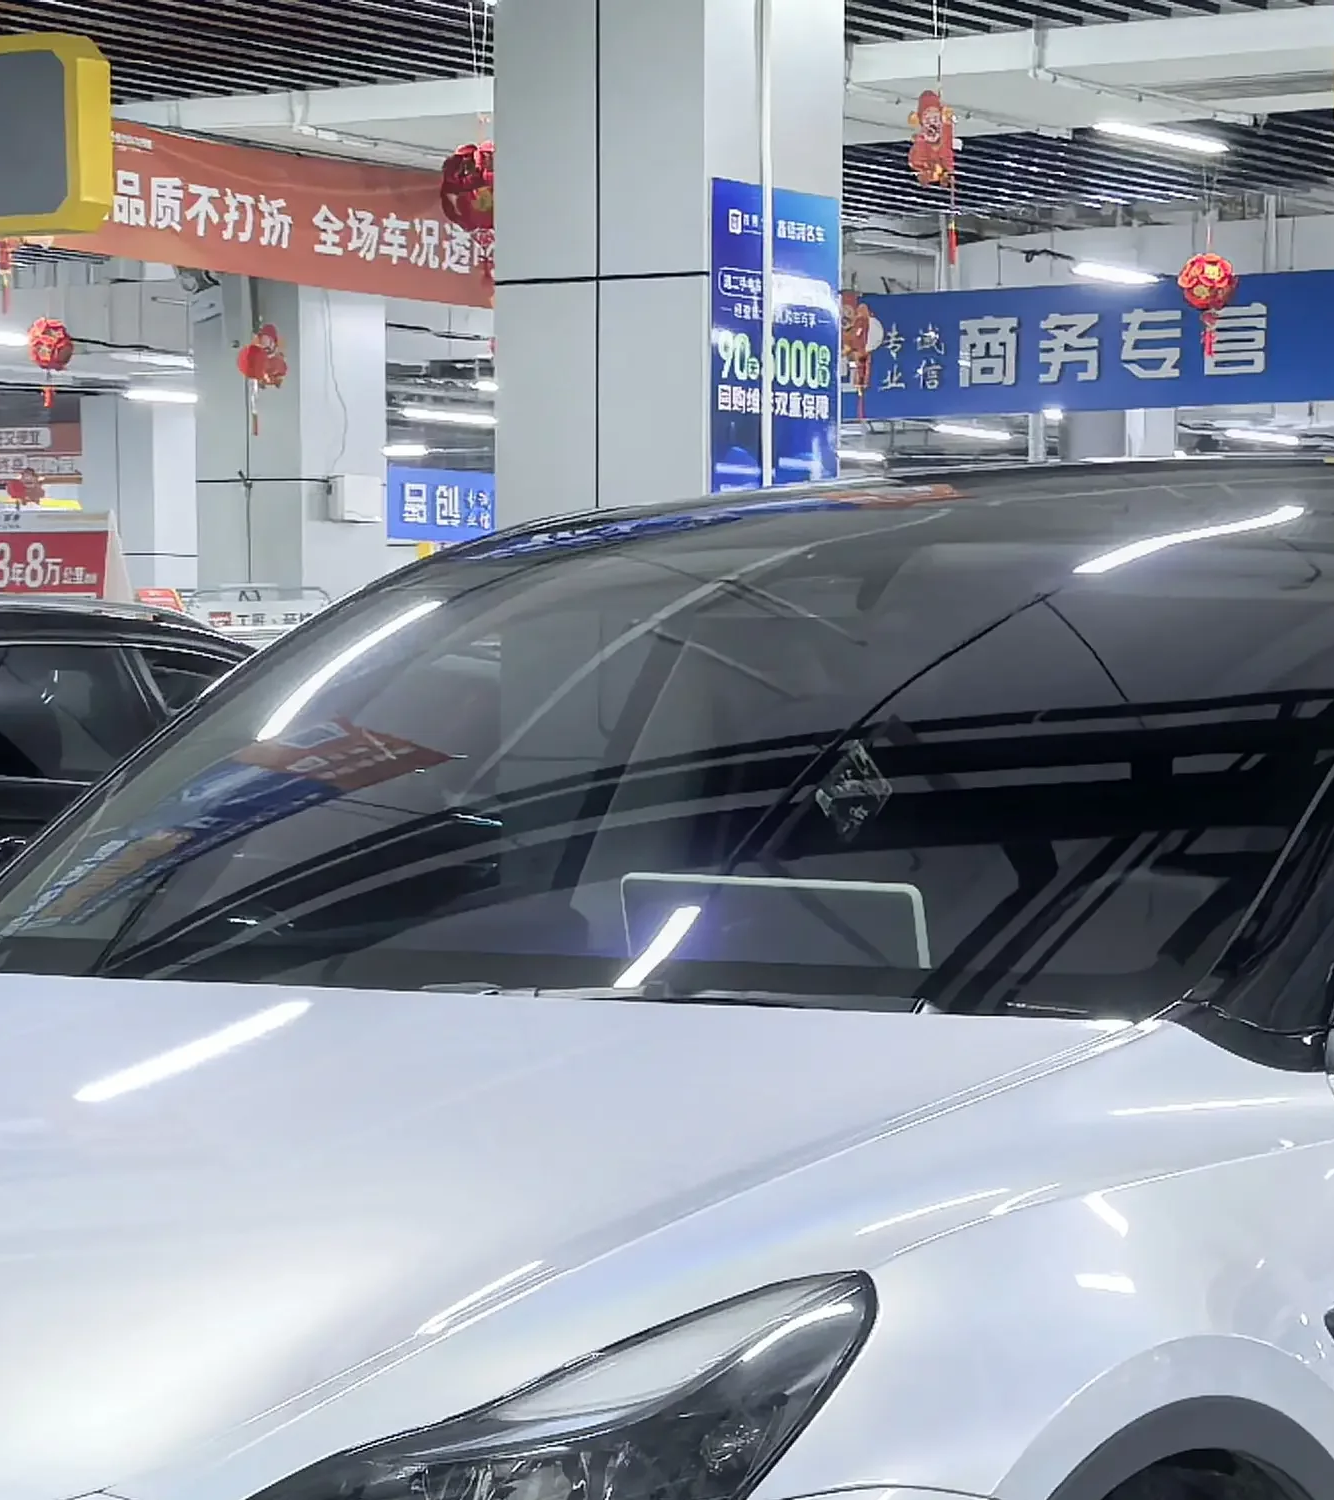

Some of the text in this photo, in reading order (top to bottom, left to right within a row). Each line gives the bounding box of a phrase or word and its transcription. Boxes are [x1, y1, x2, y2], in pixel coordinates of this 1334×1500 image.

[113, 170, 293, 249] 品质不打折
[958, 302, 1269, 388] 商务专营
